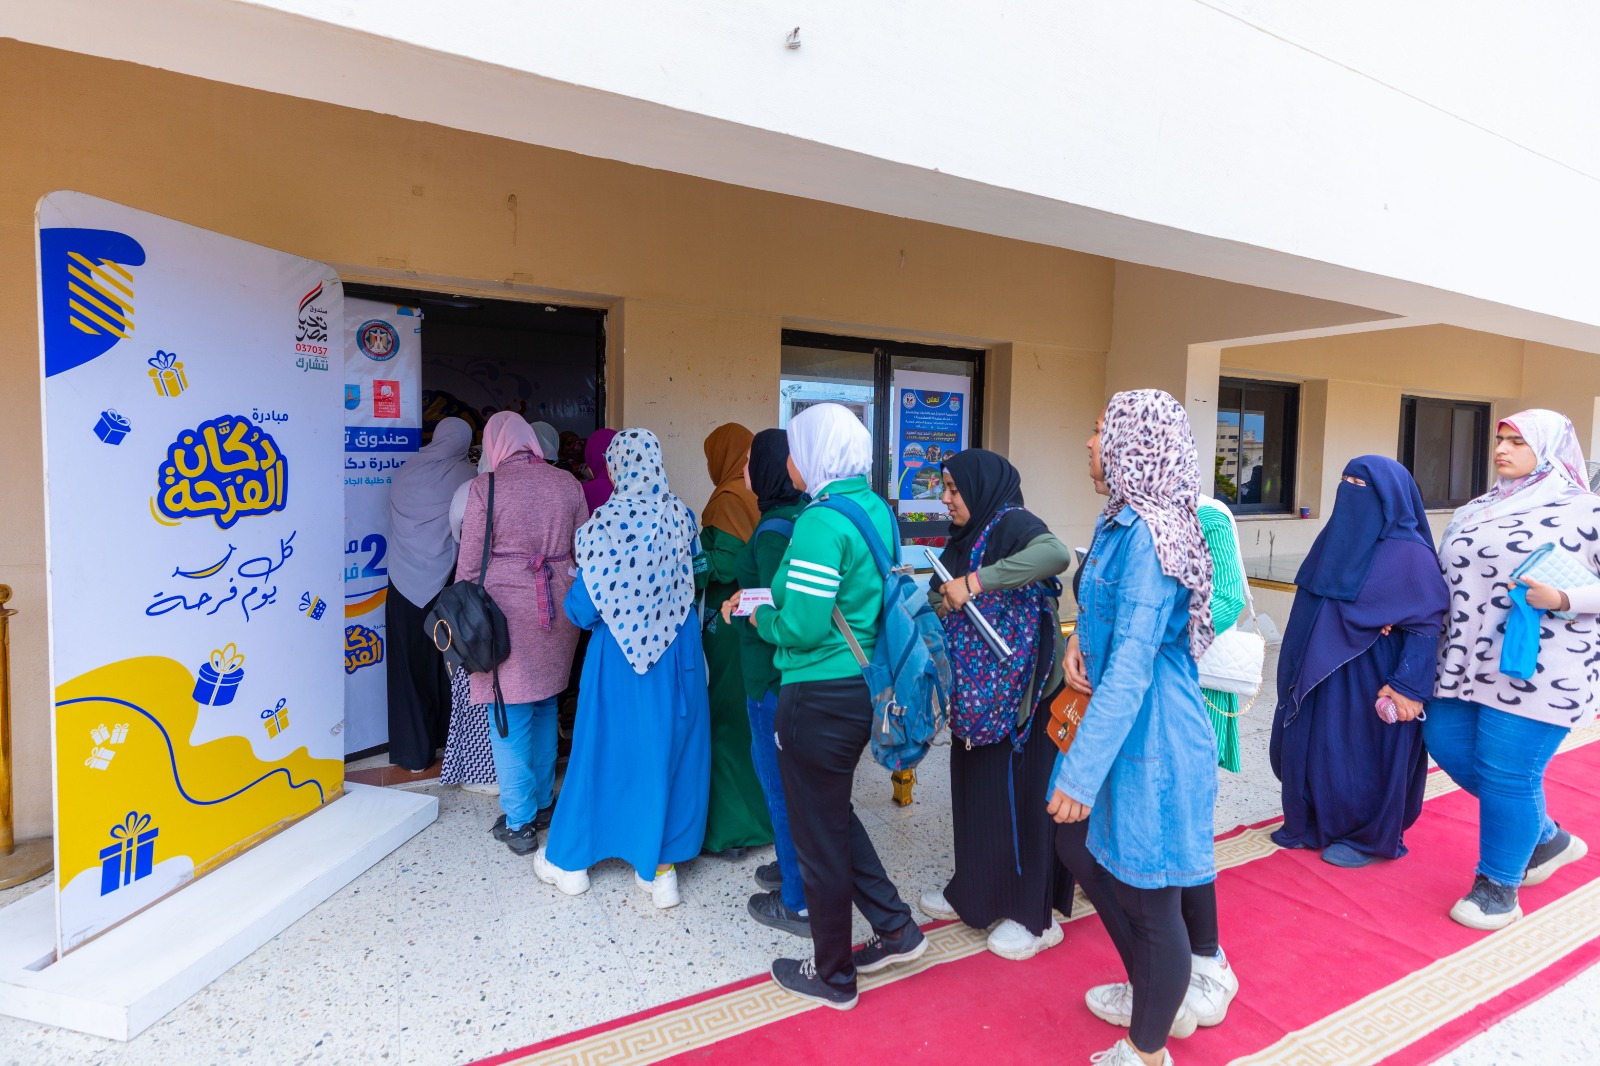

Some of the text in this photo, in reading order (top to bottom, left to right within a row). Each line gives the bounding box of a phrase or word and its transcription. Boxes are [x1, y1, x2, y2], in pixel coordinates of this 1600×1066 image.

[295, 343, 328, 355] 037037
[295, 357, 329, 373] نتشارك
[252, 408, 289, 424] مبادرة
[354, 431, 409, 448] صندوق
[361, 533, 388, 579] 2
[145, 577, 278, 623] يوم فرحة
